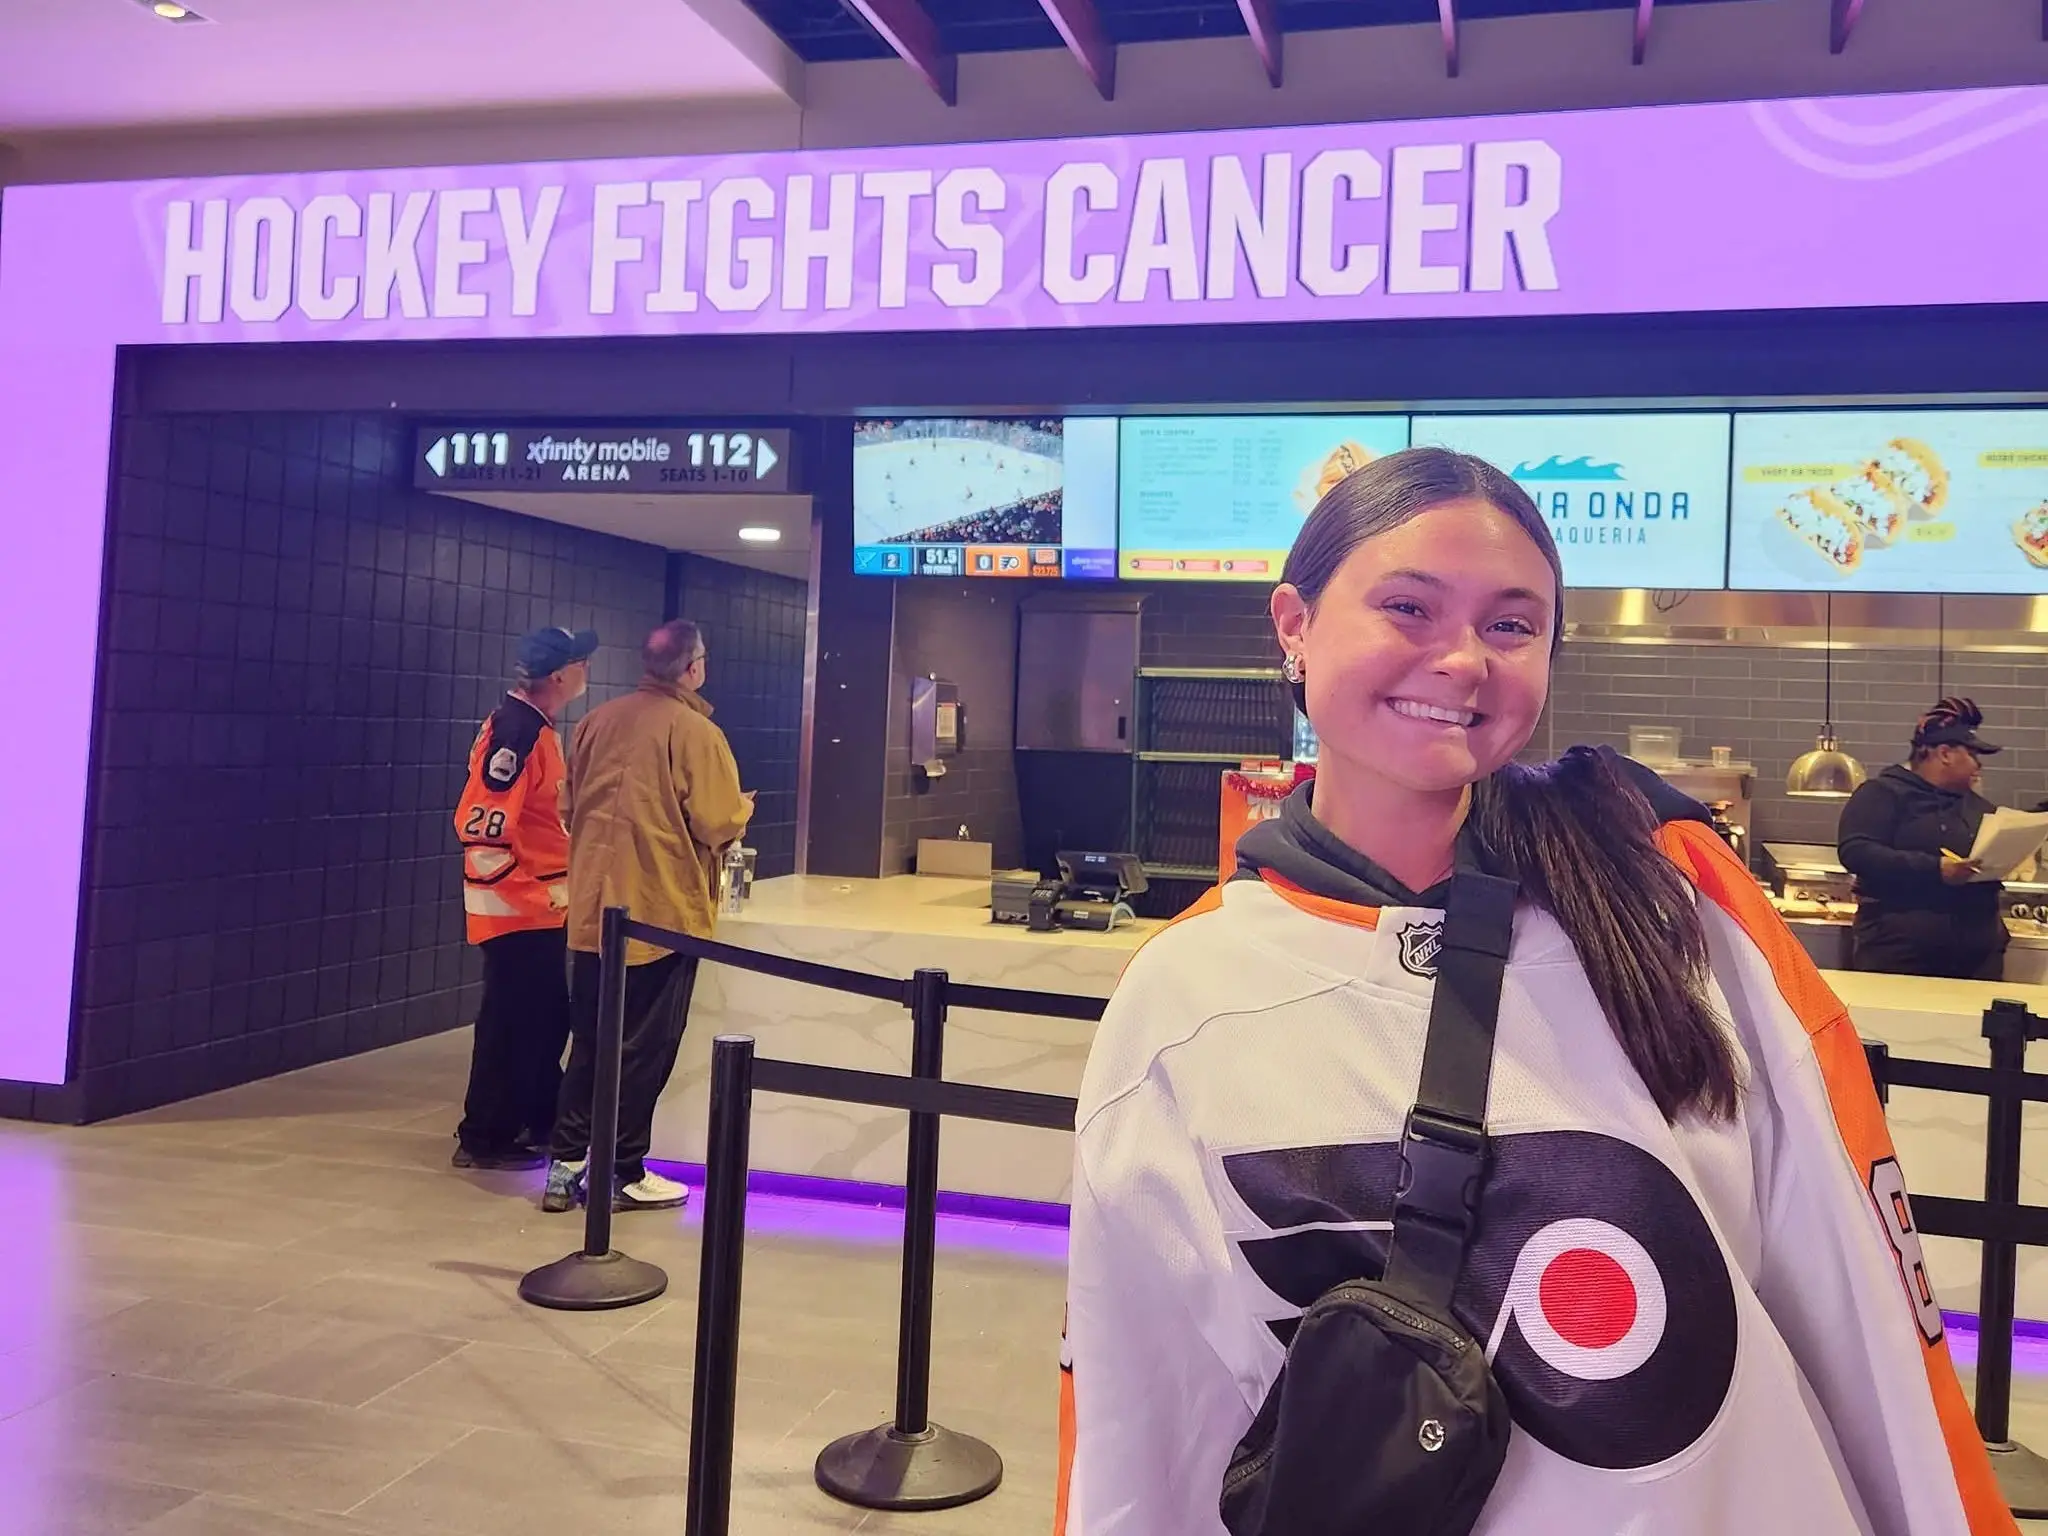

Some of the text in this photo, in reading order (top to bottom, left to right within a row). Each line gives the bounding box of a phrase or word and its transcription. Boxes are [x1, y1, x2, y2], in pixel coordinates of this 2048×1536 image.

[161, 138, 1563, 325] HOCKEY FIGHTS CANCER
[450, 432, 509, 466] 111
[526, 435, 671, 465] xfinity mobile
[687, 433, 753, 467] 112
[561, 464, 631, 482] ARENA
[659, 467, 749, 483] SEATS 1-10
[1588, 491, 1690, 520] ONDA
[887, 553, 898, 568] 2
[979, 555, 990, 569] 0
[464, 804, 507, 838] 28
[1414, 938, 1442, 965] NHL
